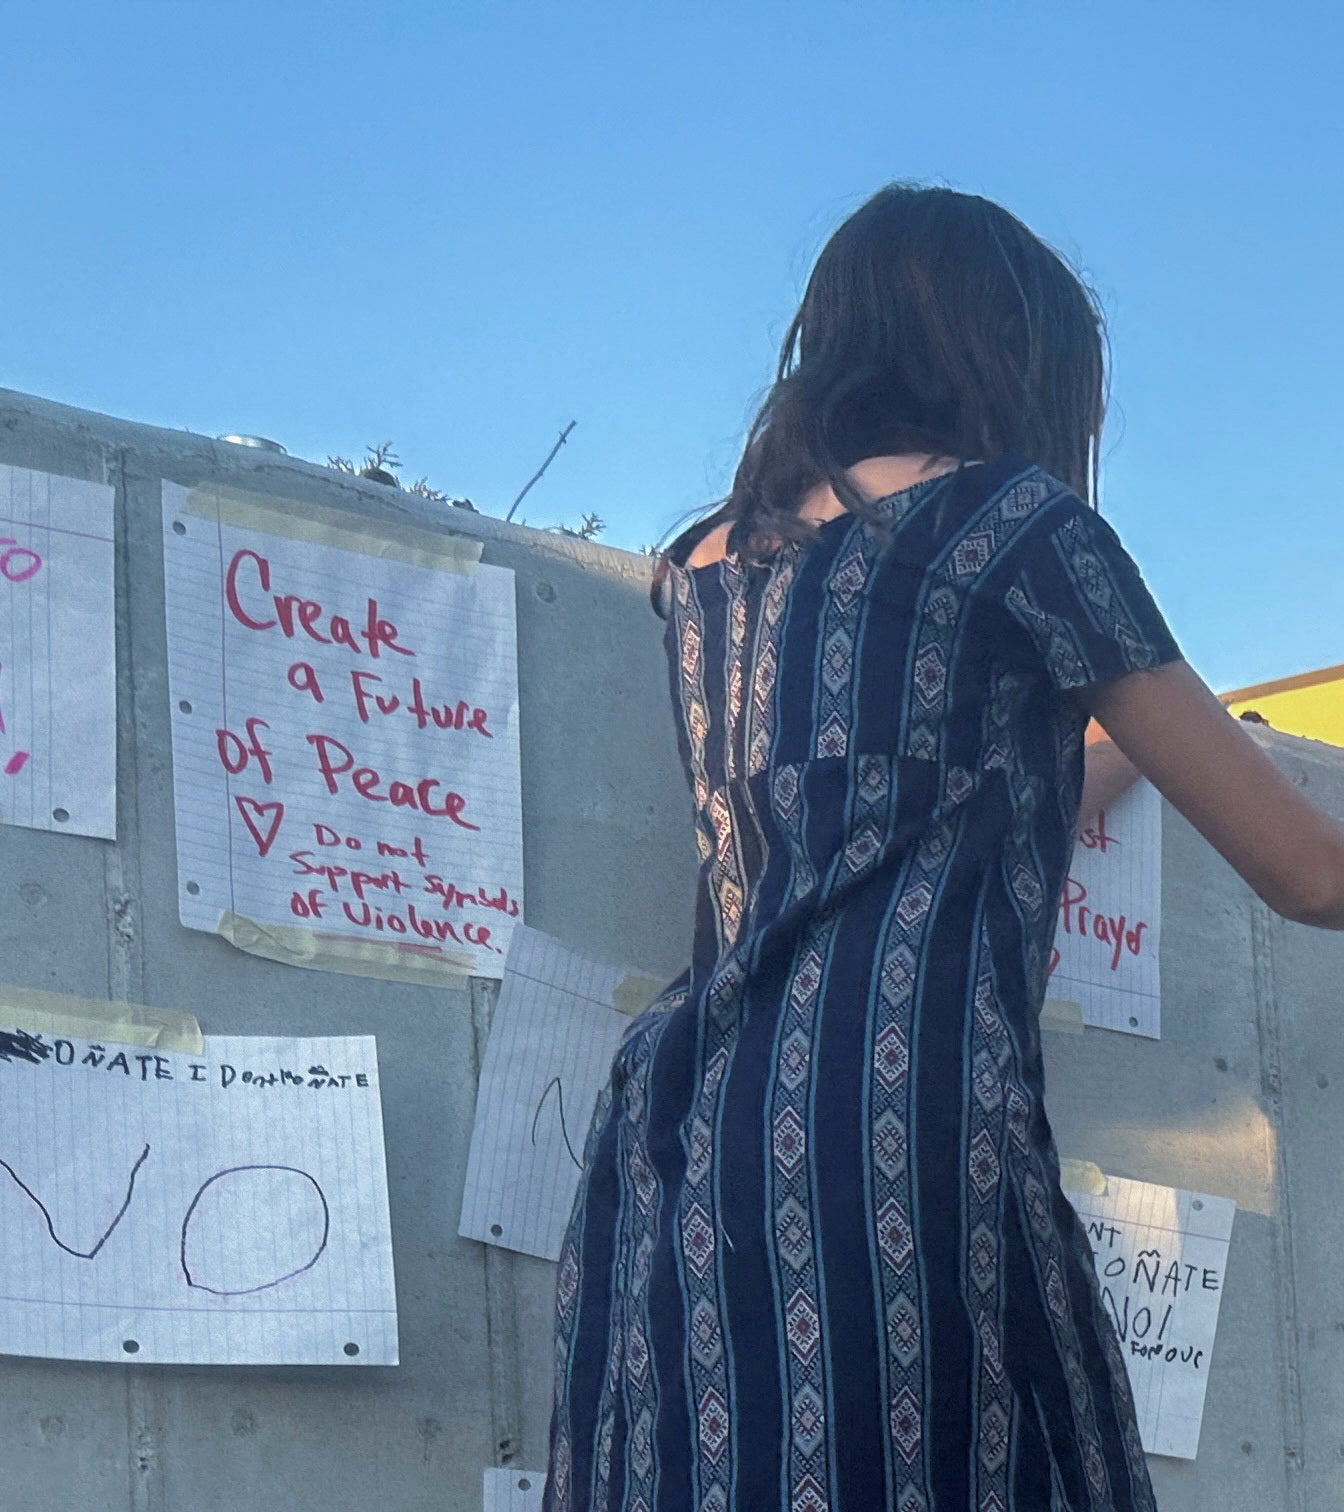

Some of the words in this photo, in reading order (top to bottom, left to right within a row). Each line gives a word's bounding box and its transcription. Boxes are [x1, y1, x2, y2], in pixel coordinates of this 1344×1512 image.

[226, 547, 416, 659] Create
[287, 661, 326, 703] a
[350, 670, 494, 740] Future
[305, 733, 481, 832] Peace
[312, 823, 362, 848] Do
[376, 836, 430, 868] not
[1103, 1249, 1220, 1299] OÑATE
